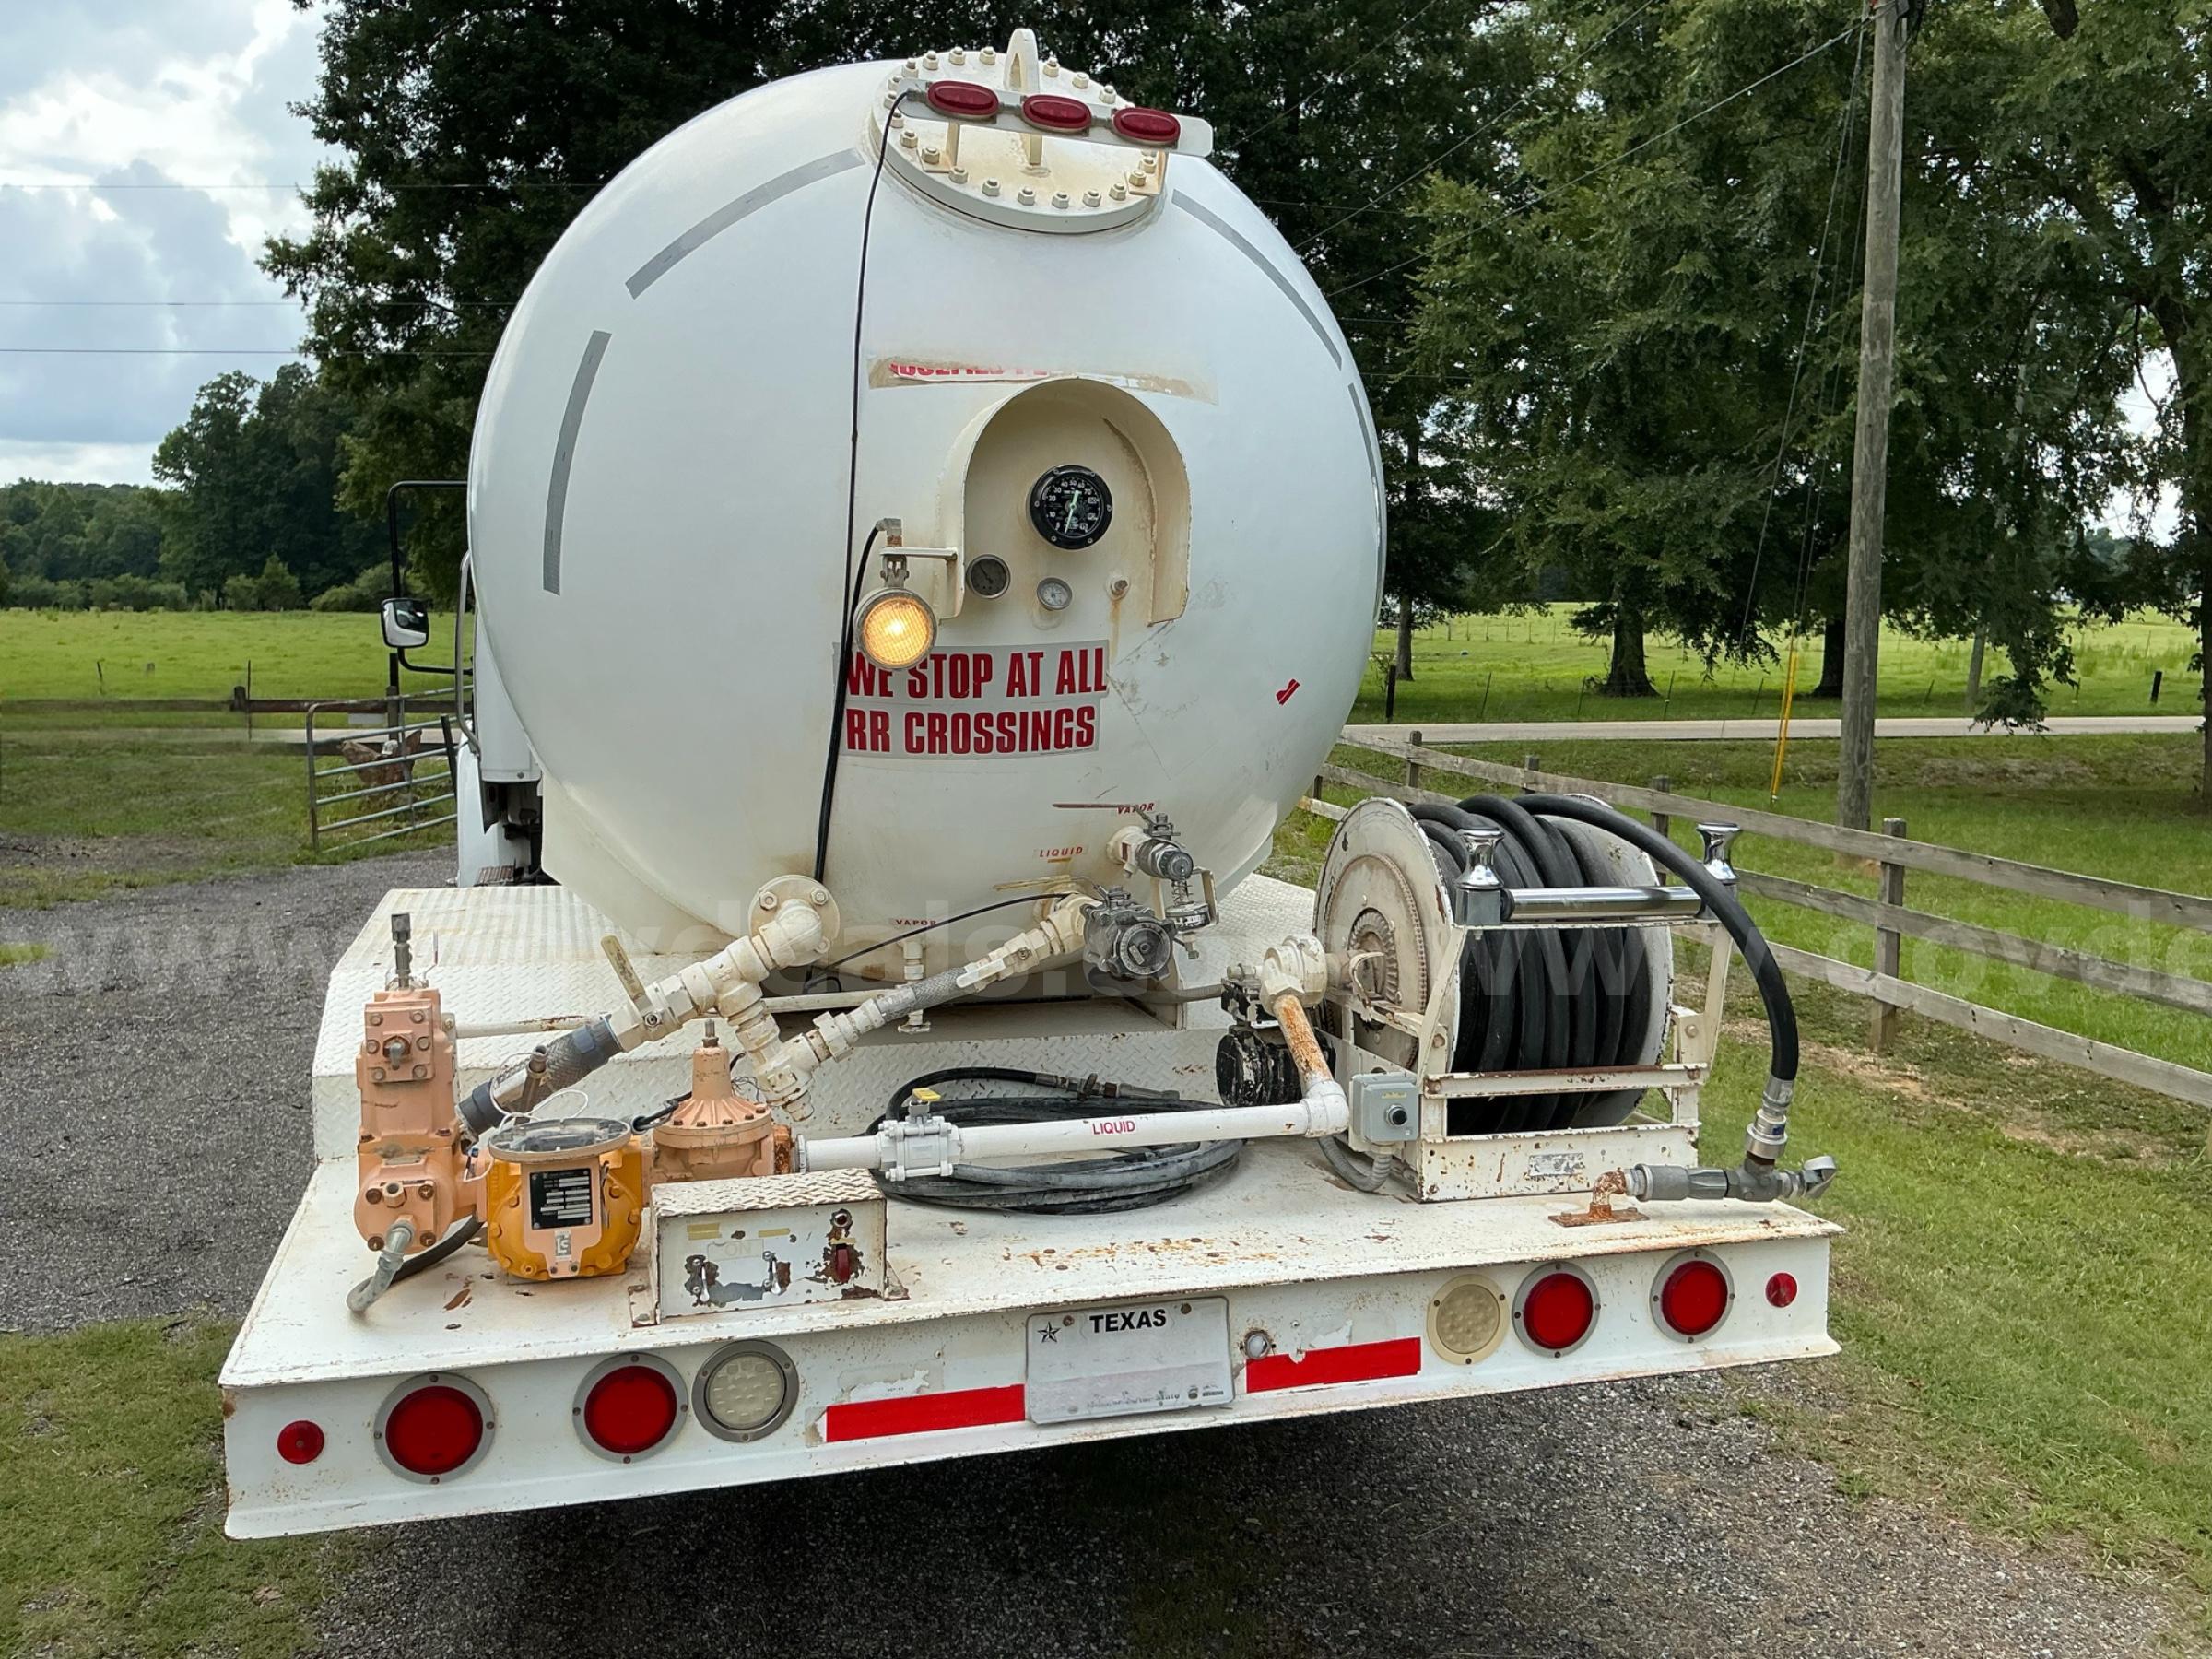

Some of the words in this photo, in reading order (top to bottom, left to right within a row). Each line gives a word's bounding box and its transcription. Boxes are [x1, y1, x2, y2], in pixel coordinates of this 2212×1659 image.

[908, 653, 993, 699] STOP
[1006, 652, 1044, 698] AT
[1055, 647, 1107, 695] ALL
[846, 709, 891, 752] RR
[904, 706, 1096, 755] CROSSINGS
[1039, 846, 1084, 858] LIQUID
[1092, 1120, 1135, 1135] LIQUID
[724, 1244, 752, 1257] ON
[1089, 1309, 1167, 1333] TEXAS
